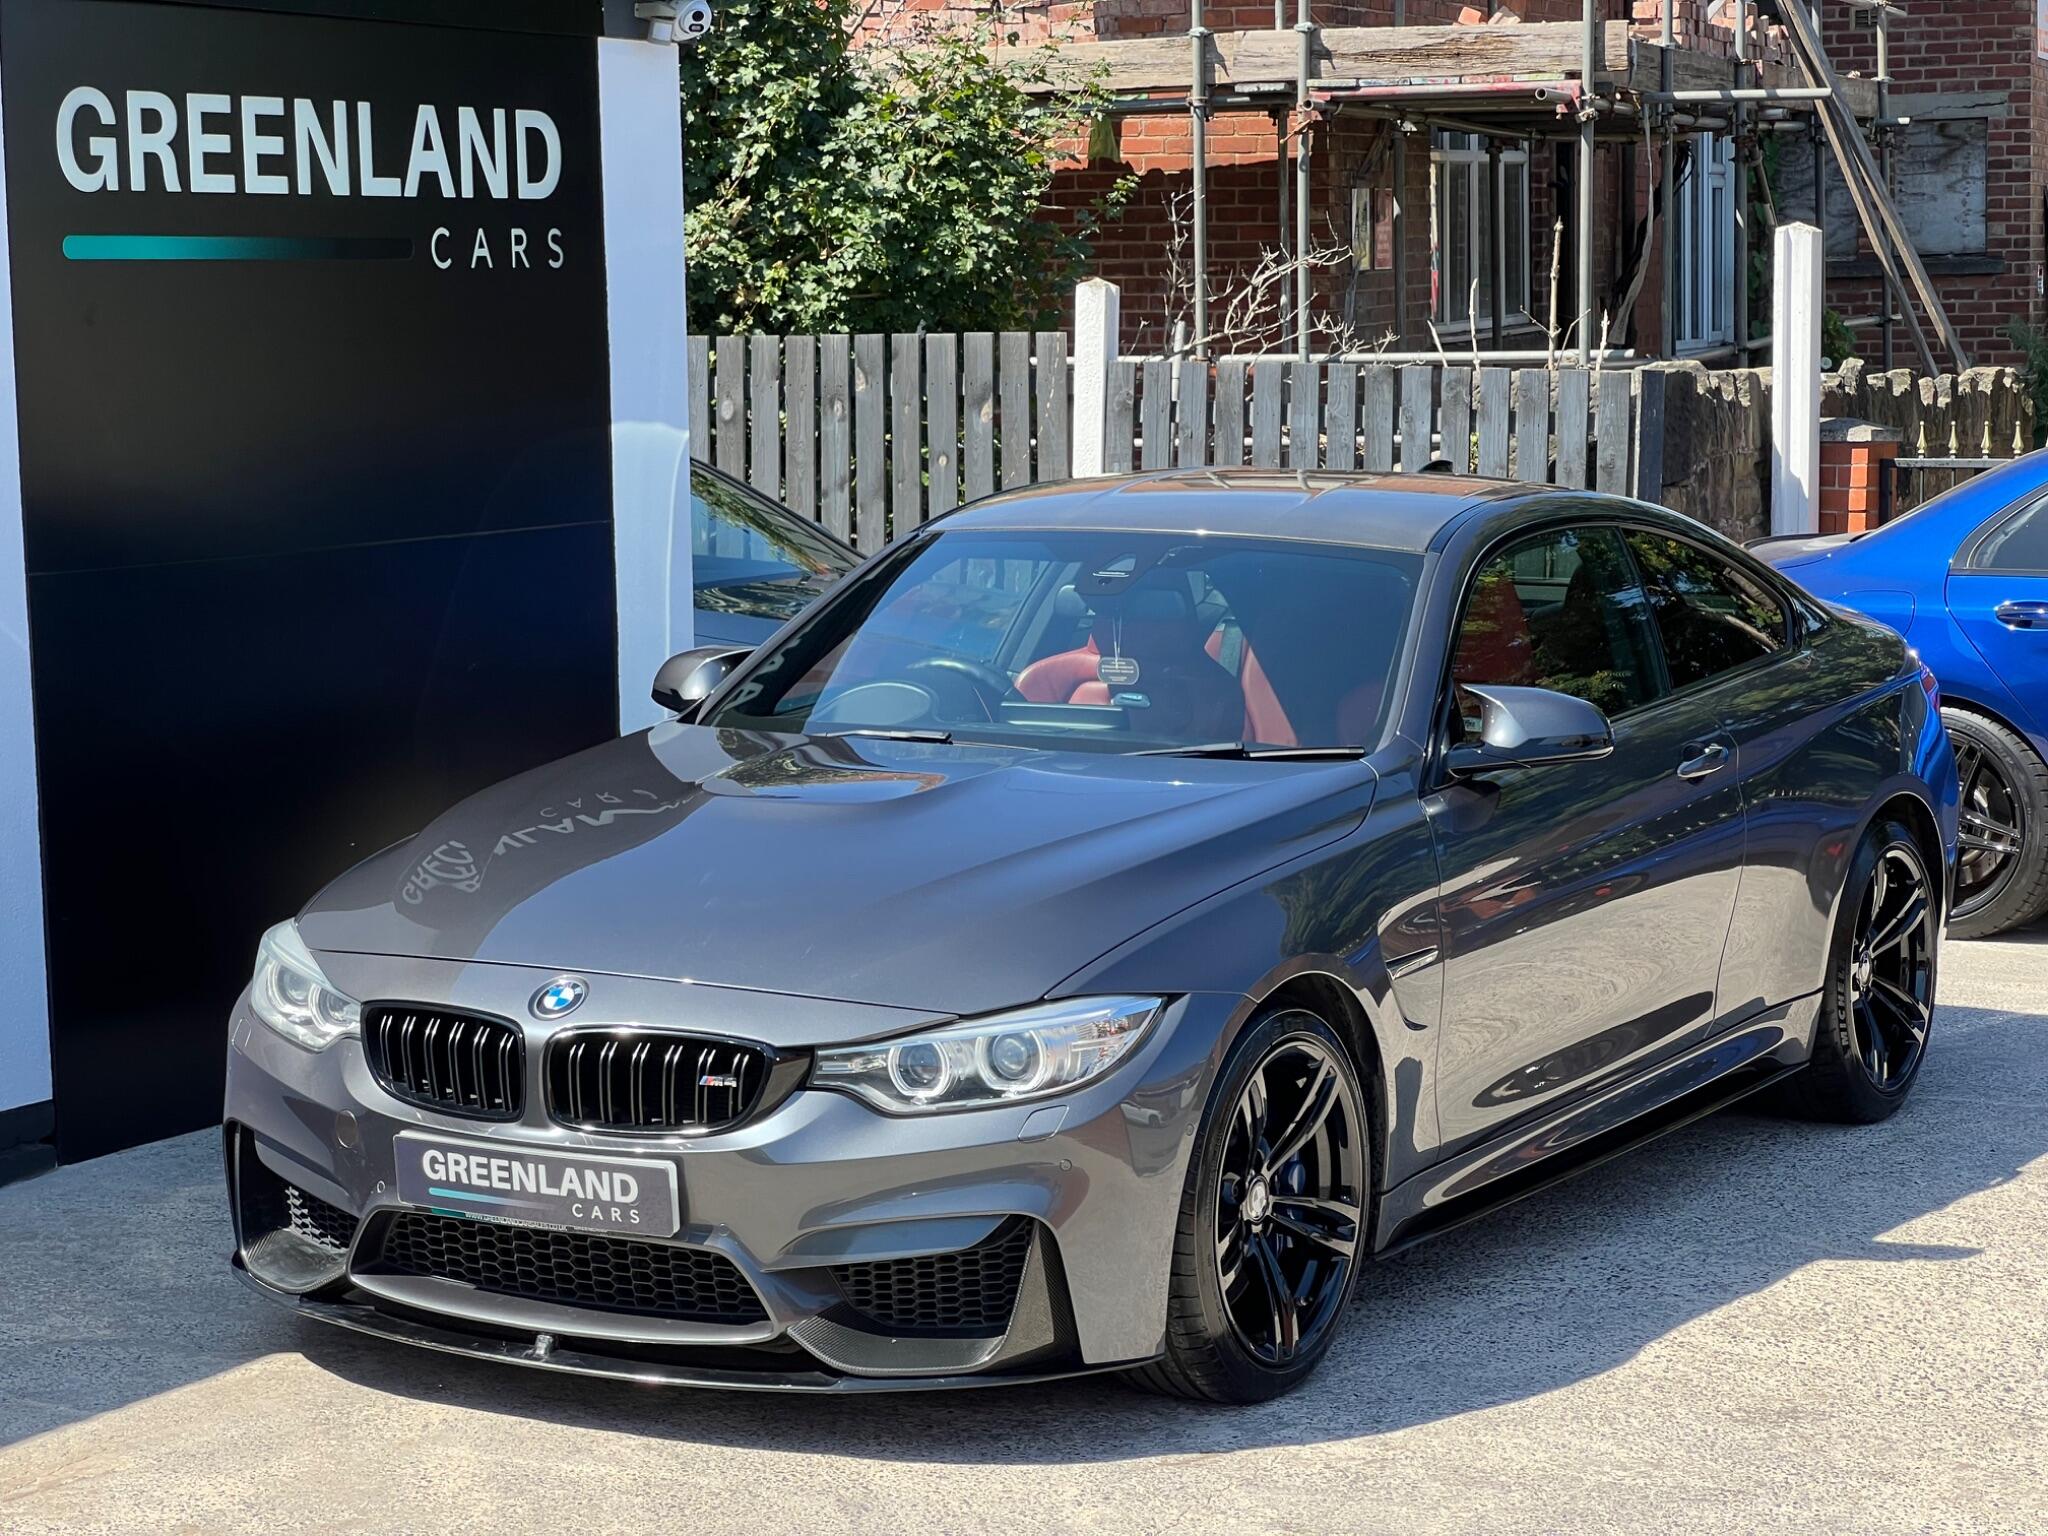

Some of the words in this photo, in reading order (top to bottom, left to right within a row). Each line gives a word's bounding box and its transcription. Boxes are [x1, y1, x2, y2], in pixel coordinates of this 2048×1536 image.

[56, 86, 562, 199] GREENLAND
[431, 227, 565, 269] CARS
[422, 1149, 640, 1204] GREENLAND
[571, 1203, 641, 1224] CARS
